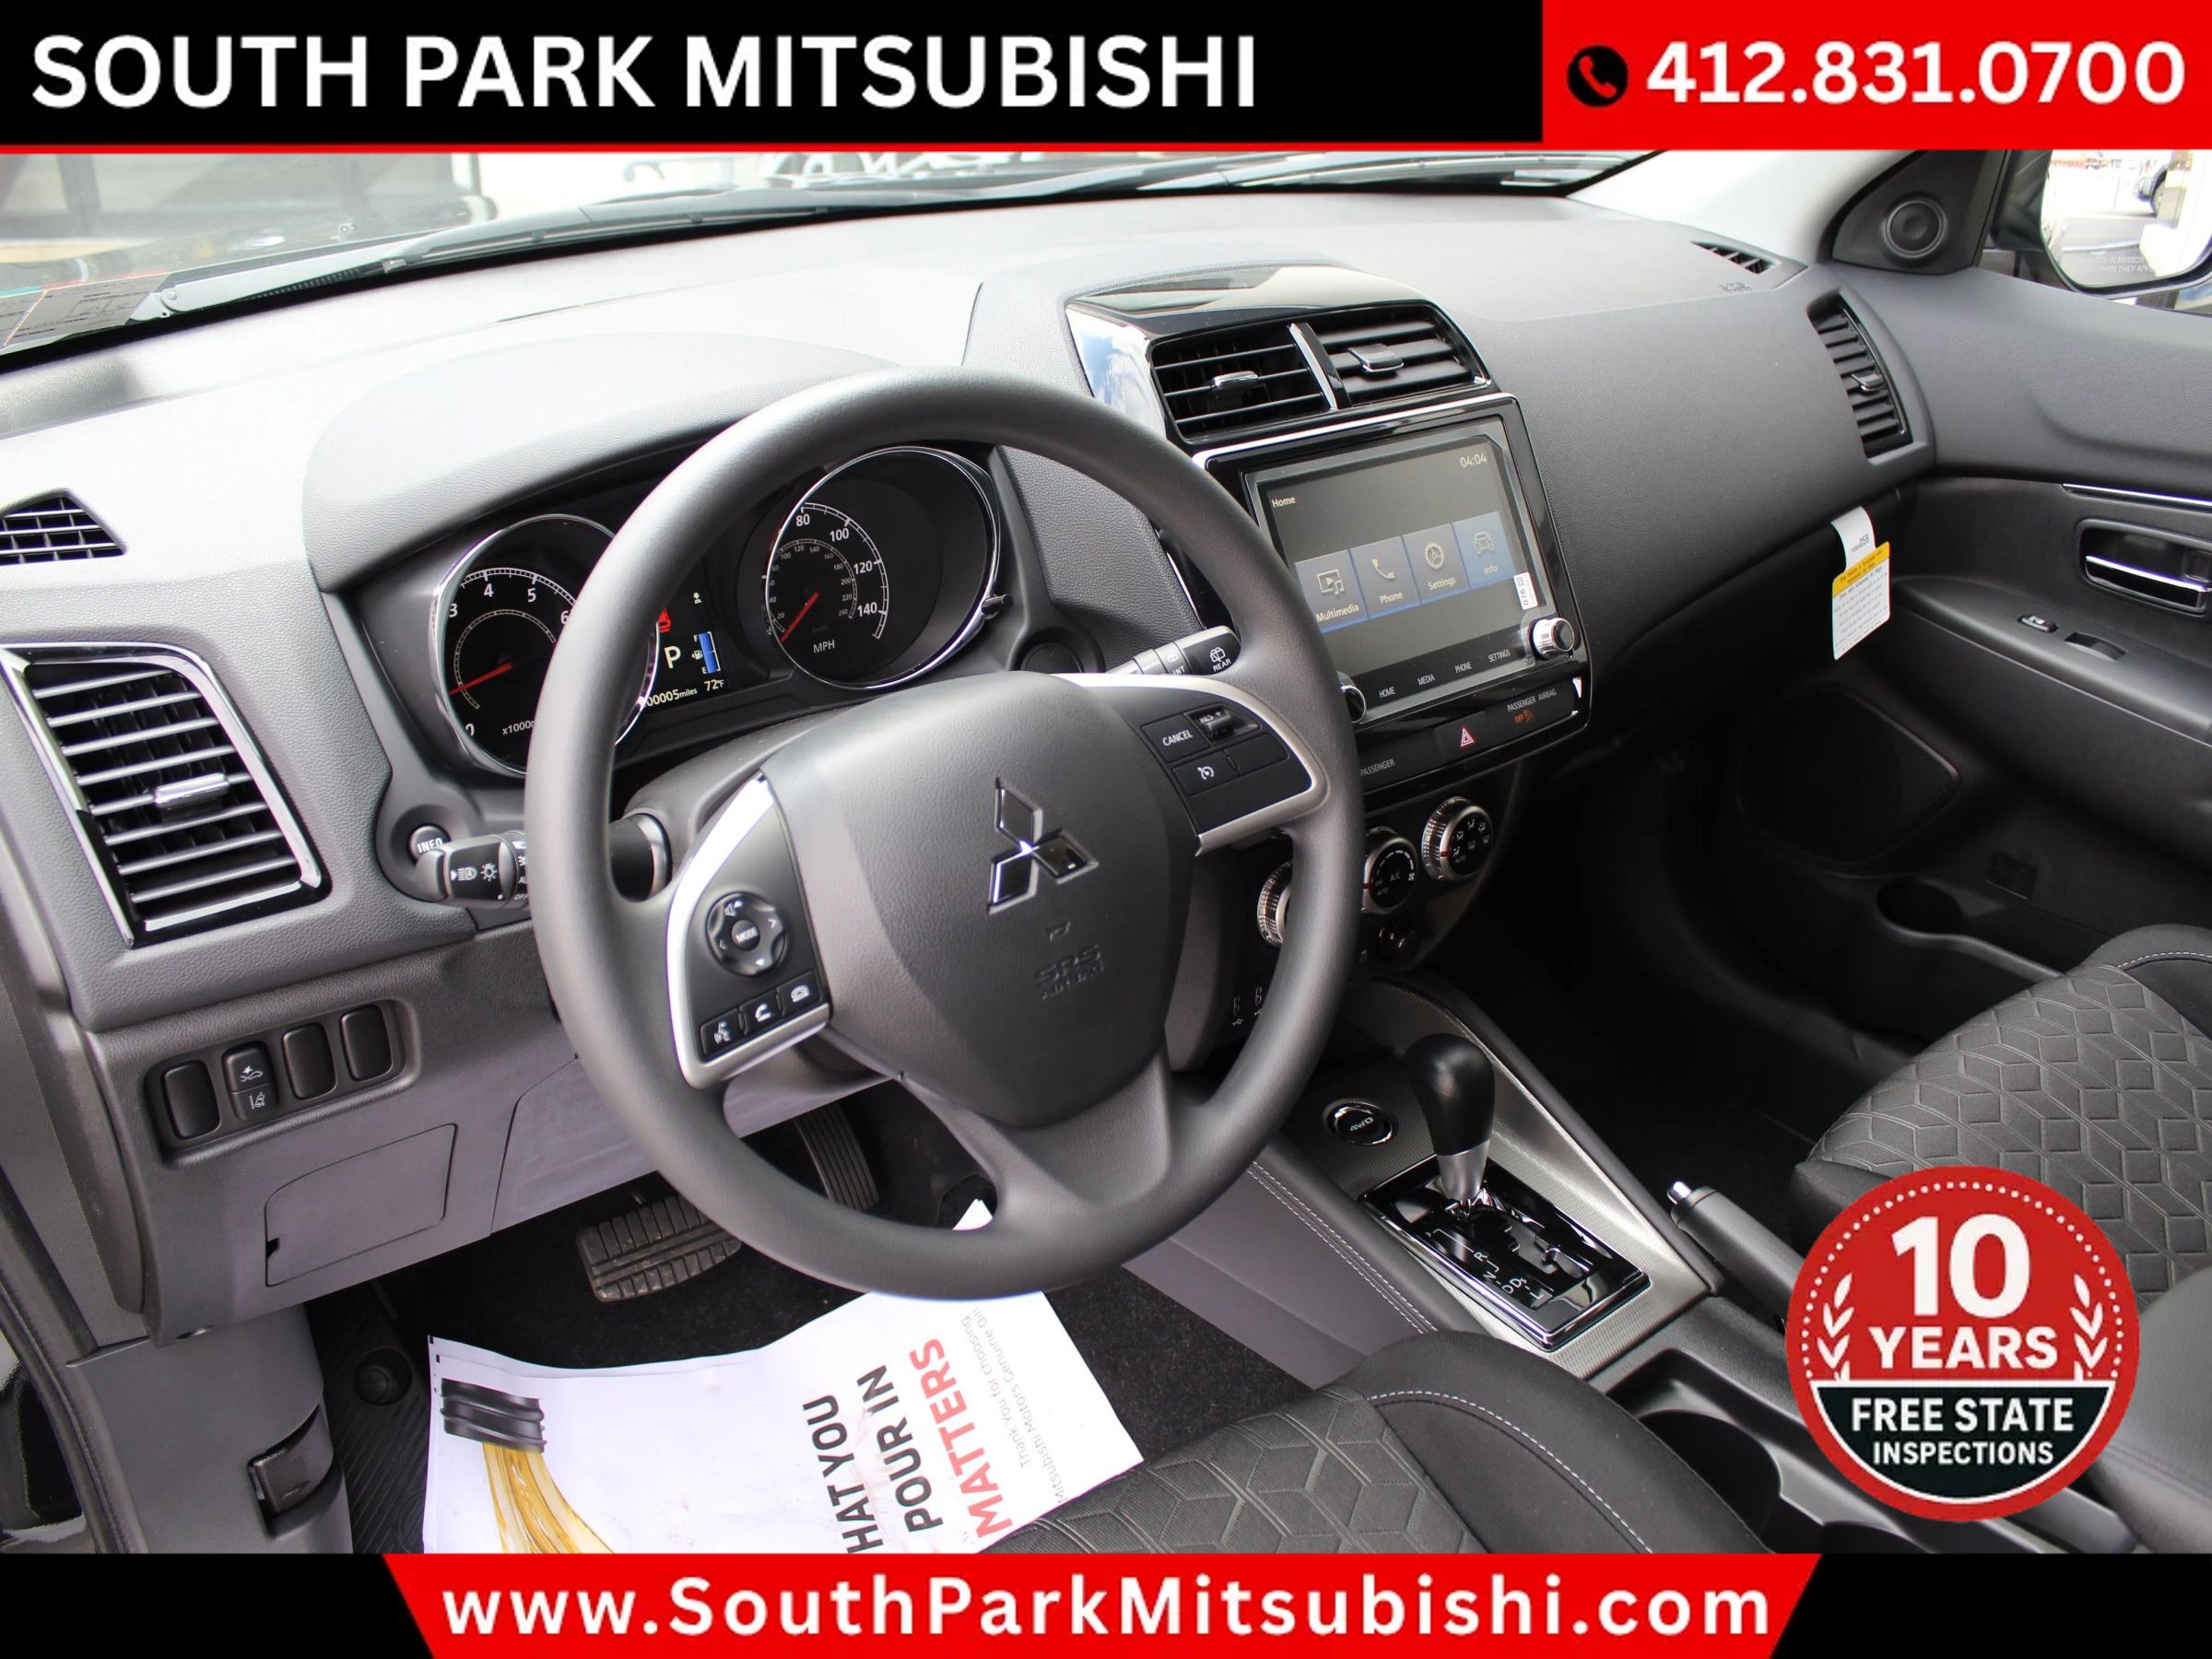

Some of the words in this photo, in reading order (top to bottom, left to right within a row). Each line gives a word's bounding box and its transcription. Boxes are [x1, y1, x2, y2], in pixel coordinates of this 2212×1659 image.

[1459, 453, 1488, 468] 04:04
[1272, 495, 1296, 508] Home
[795, 513, 810, 527] 80
[830, 527, 850, 542] 100
[853, 560, 873, 574] 120
[1483, 563, 1499, 574] Info
[484, 583, 494, 597] 4
[1427, 575, 1456, 592] Settings
[527, 587, 536, 603] 5
[1379, 590, 1404, 605] Phone
[449, 603, 458, 618] 3
[560, 610, 570, 626] 6
[857, 602, 877, 618] 140
[1315, 602, 1359, 623] Multimedia
[813, 639, 835, 653] MPH
[664, 645, 681, 669] P
[1488, 649, 1511, 663] SETTINGS
[1213, 658, 1232, 673] REAR
[1454, 661, 1472, 674] PHONE
[1418, 674, 1435, 686] MEDIA
[1379, 685, 1396, 699] HOME
[1507, 696, 1536, 712] PASSENGER
[1538, 688, 1557, 700] AIRBAG
[1162, 729, 1194, 747] CANCEL
[1359, 759, 1395, 777] PASSENGER
[417, 837, 443, 853] INFO
[735, 926, 758, 944] MODE
[1349, 1116, 1373, 1132] 4WD
[1474, 1252, 1488, 1262] R
[1482, 1270, 1497, 1282] N
[1501, 1285, 1513, 1294] D
[961, 1315, 993, 1375] choosing
[985, 1330, 1015, 1383] Genuine
[856, 1364, 900, 1414] IN
[987, 1378, 1001, 1397] for
[998, 1397, 1013, 1426] You
[1011, 1383, 1036, 1433] Motors
[803, 1394, 854, 1478] YOU
[909, 1338, 1013, 1538] MATTERS
[1009, 1426, 1031, 1468] Thank
[877, 1417, 944, 1532] POUR
[1032, 1434, 1068, 1504] Mitsubishi
